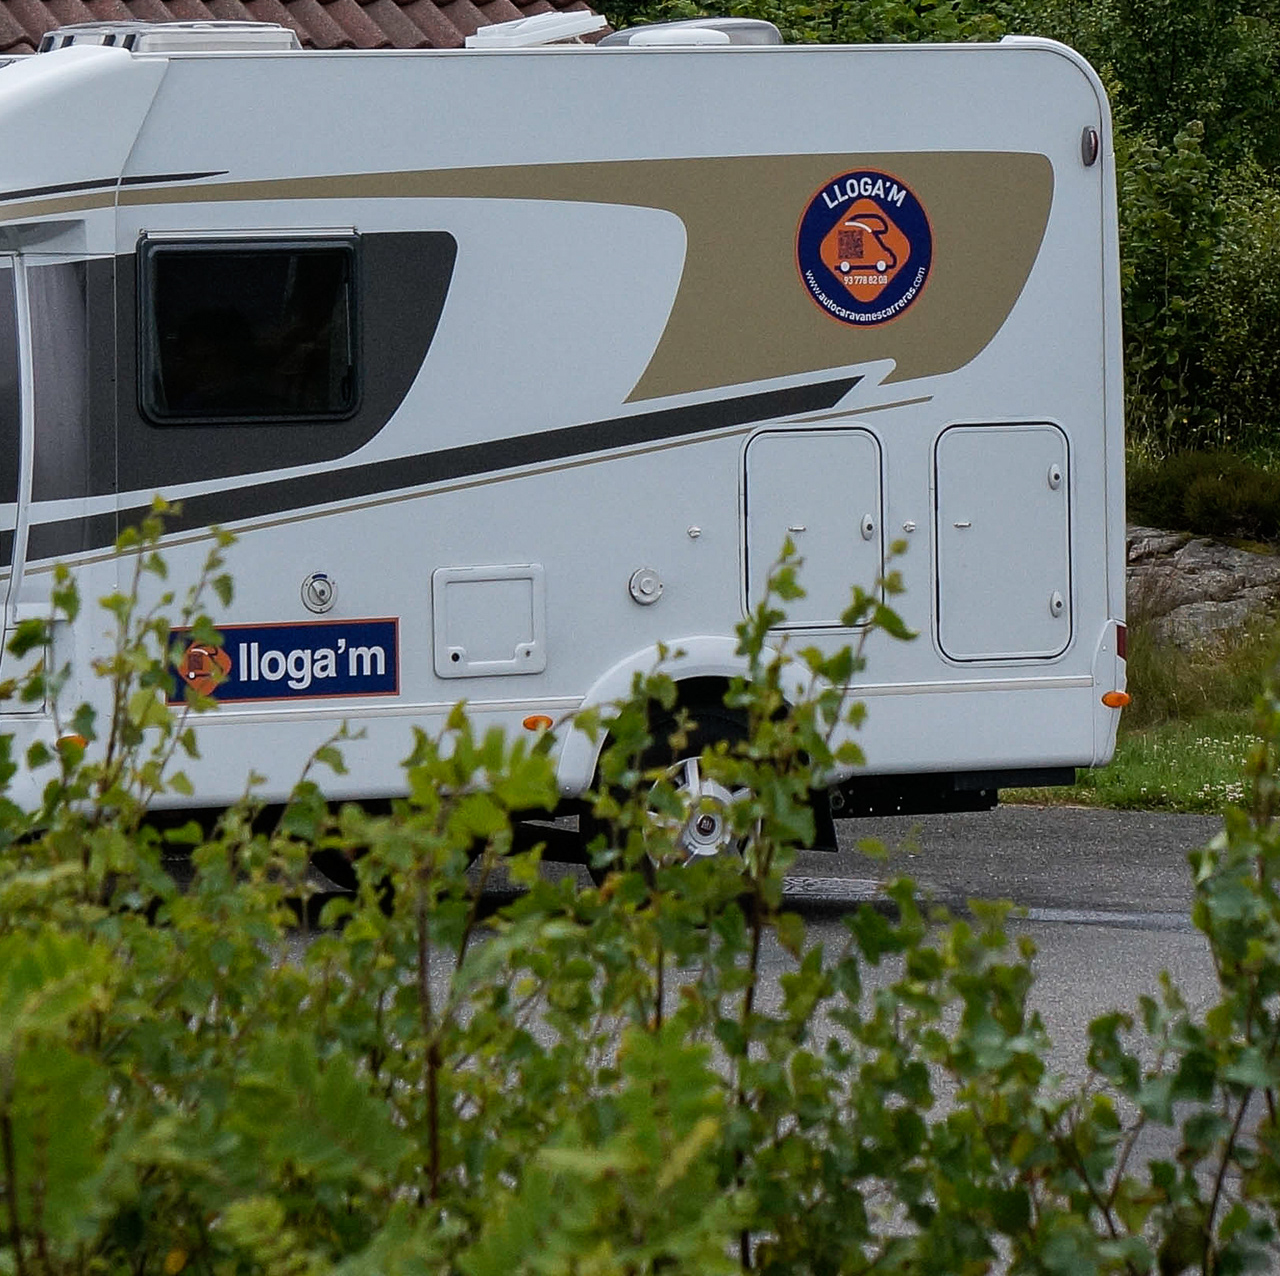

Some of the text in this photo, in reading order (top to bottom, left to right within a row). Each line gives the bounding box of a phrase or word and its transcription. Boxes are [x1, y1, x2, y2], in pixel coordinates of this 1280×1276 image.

[822, 177, 907, 209] LLOGA'M
[805, 267, 926, 322] www.autocaravanescarreras.com
[239, 638, 386, 690] lloga'm
